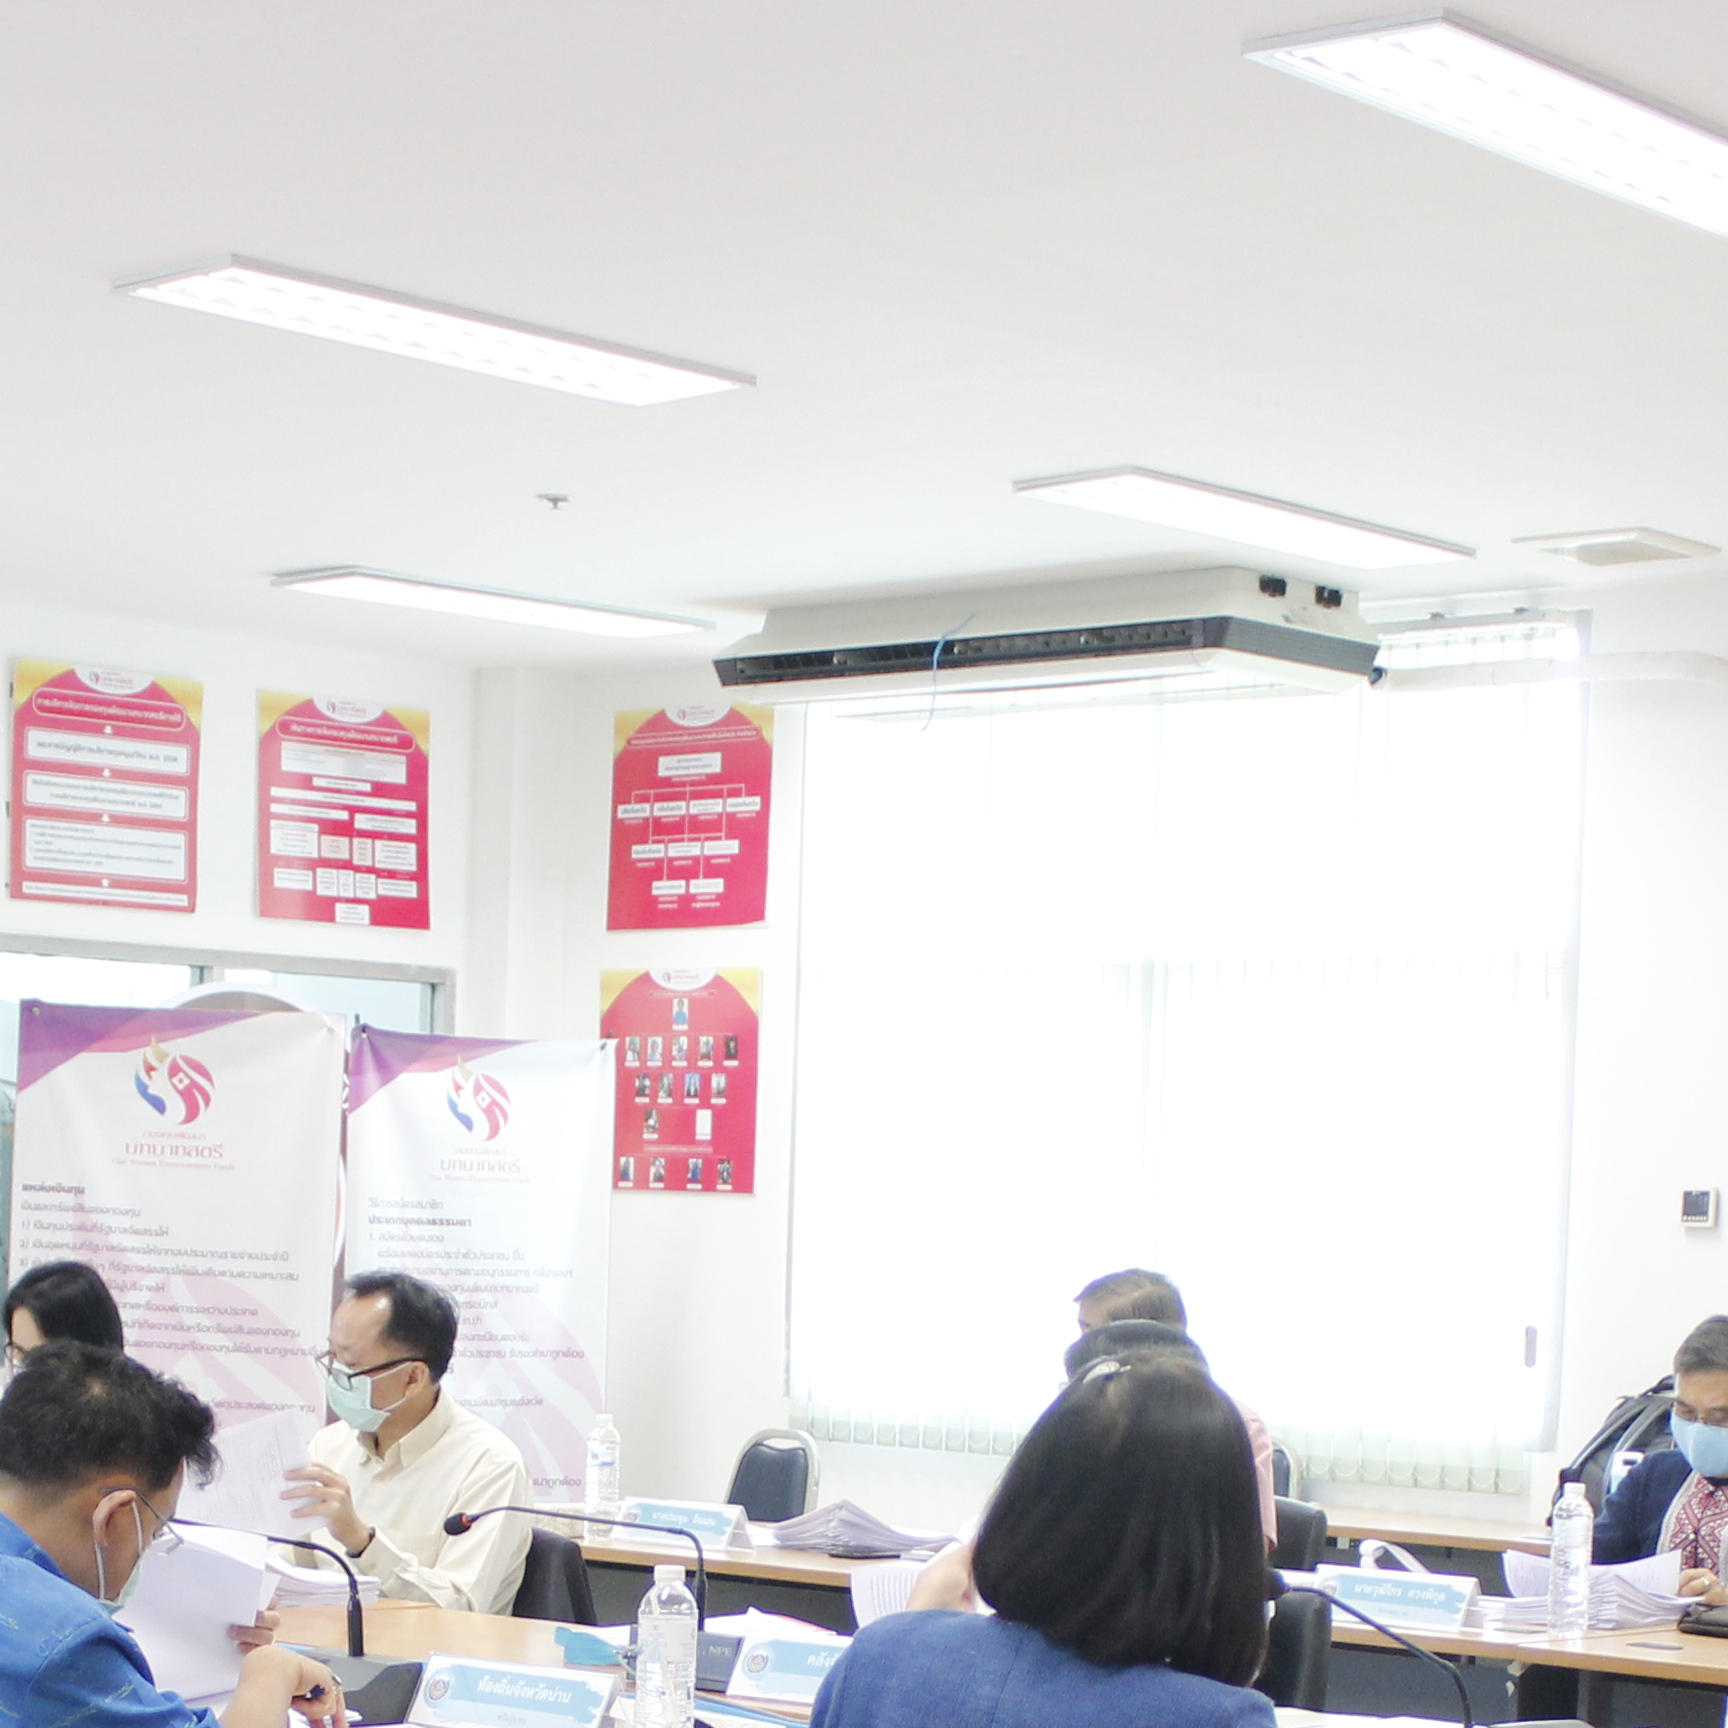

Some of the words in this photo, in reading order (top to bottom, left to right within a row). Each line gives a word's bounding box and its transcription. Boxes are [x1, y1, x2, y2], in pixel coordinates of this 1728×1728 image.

[124, 1141, 225, 1159] บทบาทสตรี
[440, 1157, 521, 1173] บทบาทสตรี
[477, 1674, 573, 1704] ท้องถิ่นจังหวัดน่าน
